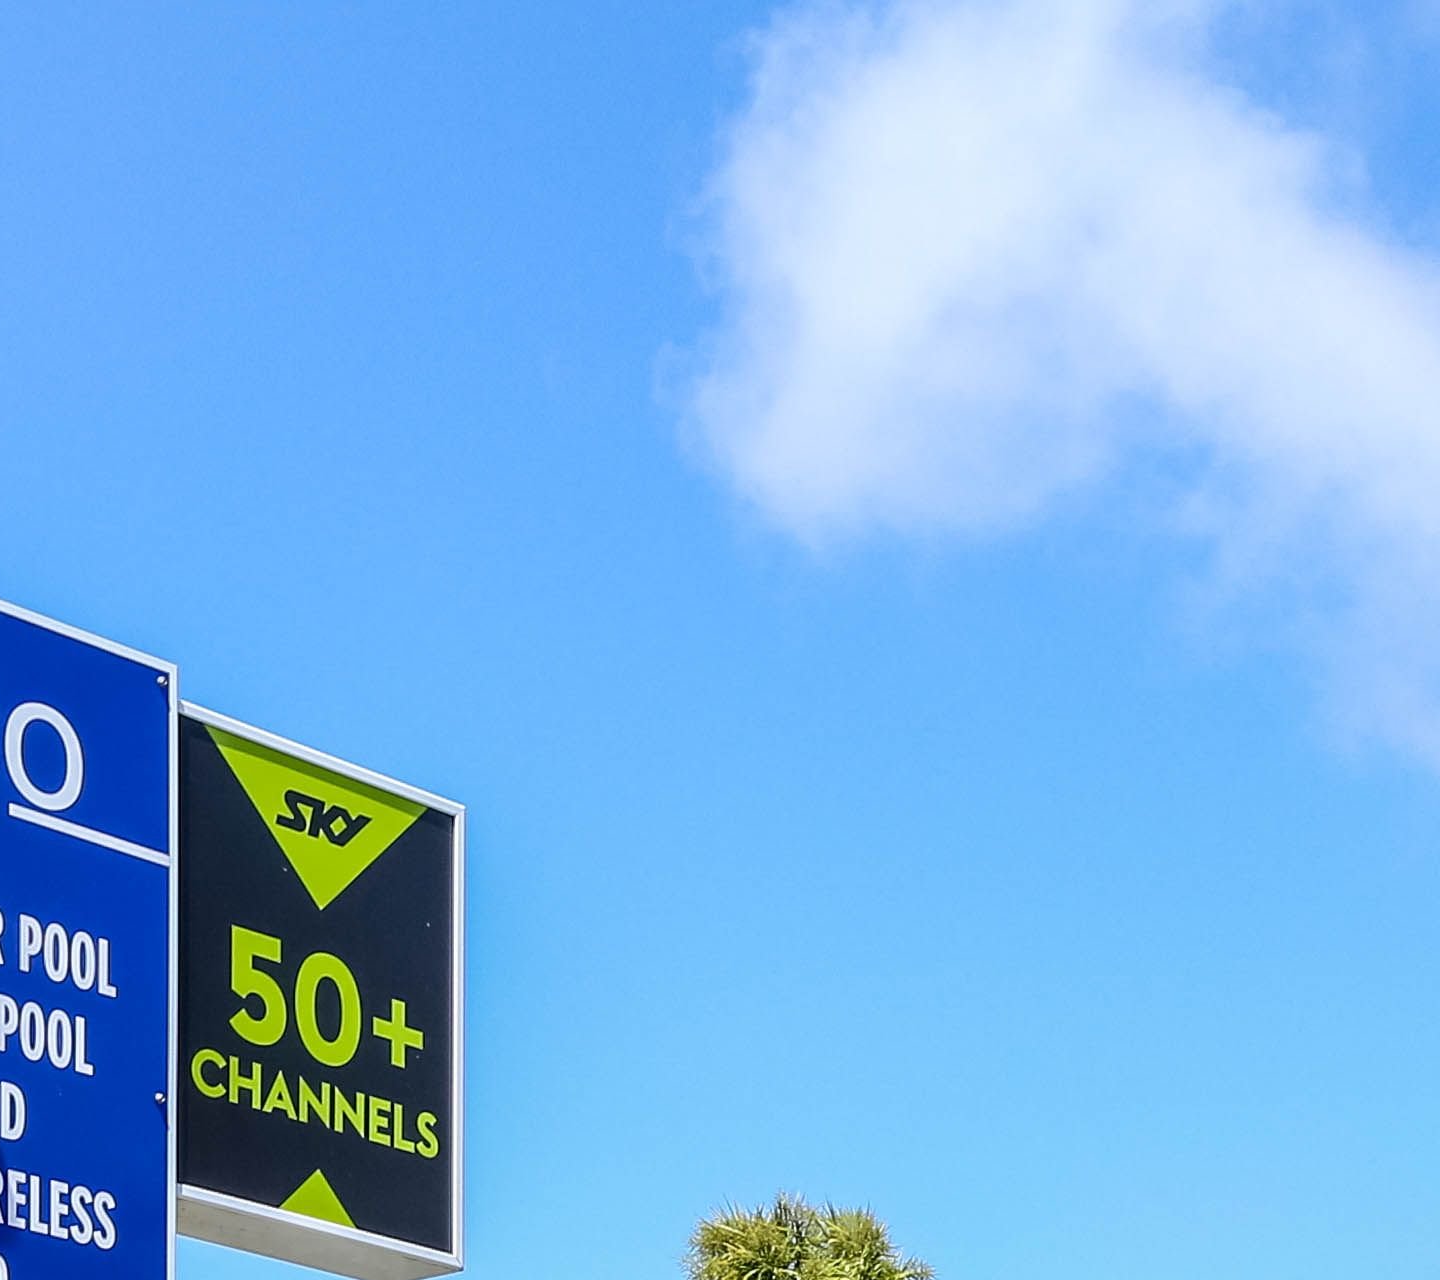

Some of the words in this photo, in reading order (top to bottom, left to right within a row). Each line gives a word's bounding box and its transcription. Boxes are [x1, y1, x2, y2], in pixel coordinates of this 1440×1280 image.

[275, 790, 372, 847] SKY
[19, 914, 118, 999] POOL
[228, 924, 424, 1070] 50+
[190, 1047, 440, 1159] CHANNELS
